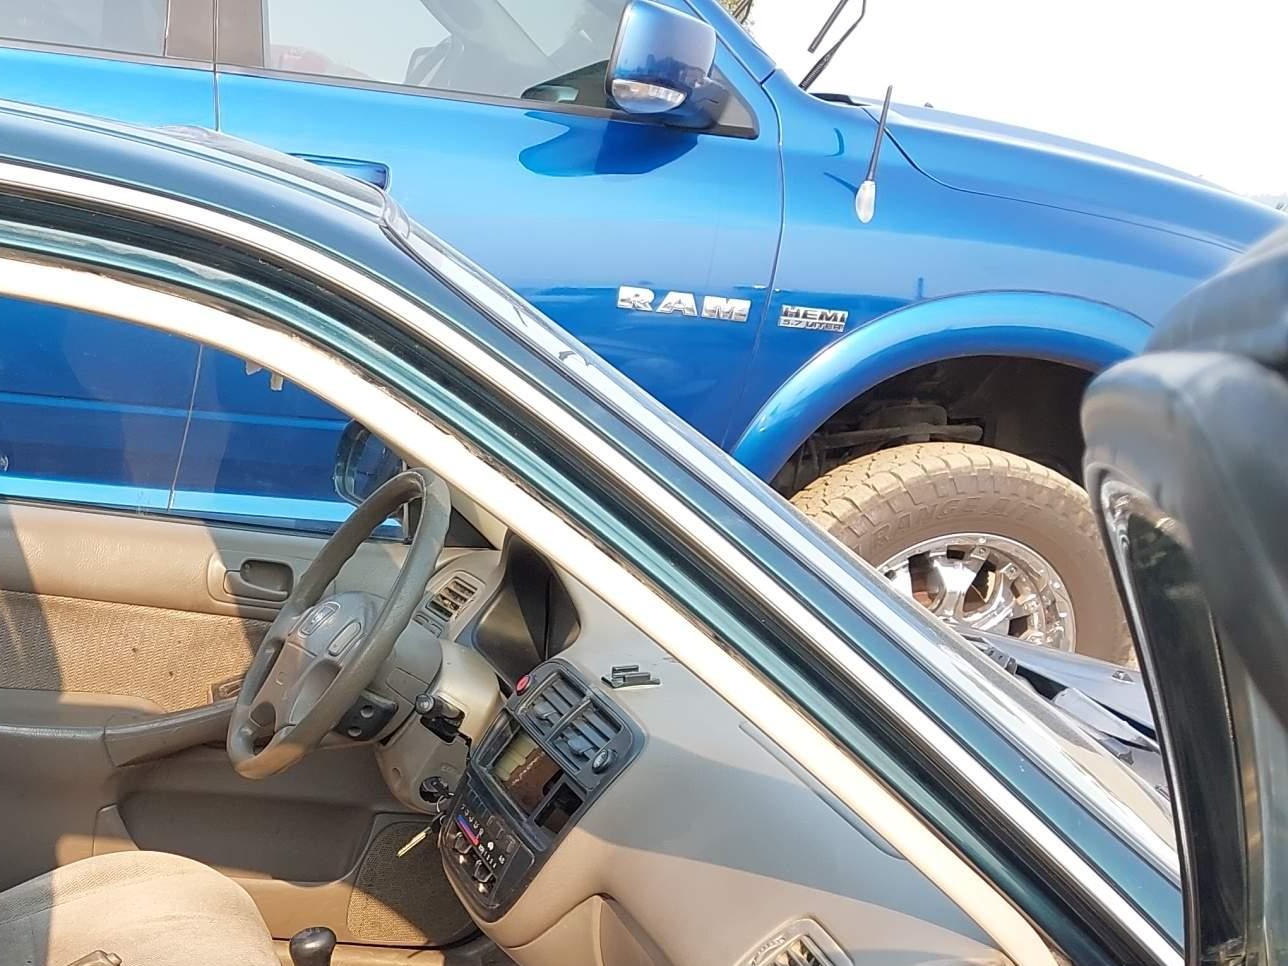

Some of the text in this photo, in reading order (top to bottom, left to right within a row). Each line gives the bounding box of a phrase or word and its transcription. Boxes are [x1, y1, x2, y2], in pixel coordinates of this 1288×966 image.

[616, 285, 752, 322] RAM
[781, 318, 803, 327] 5.7
[782, 306, 846, 323] HEMI
